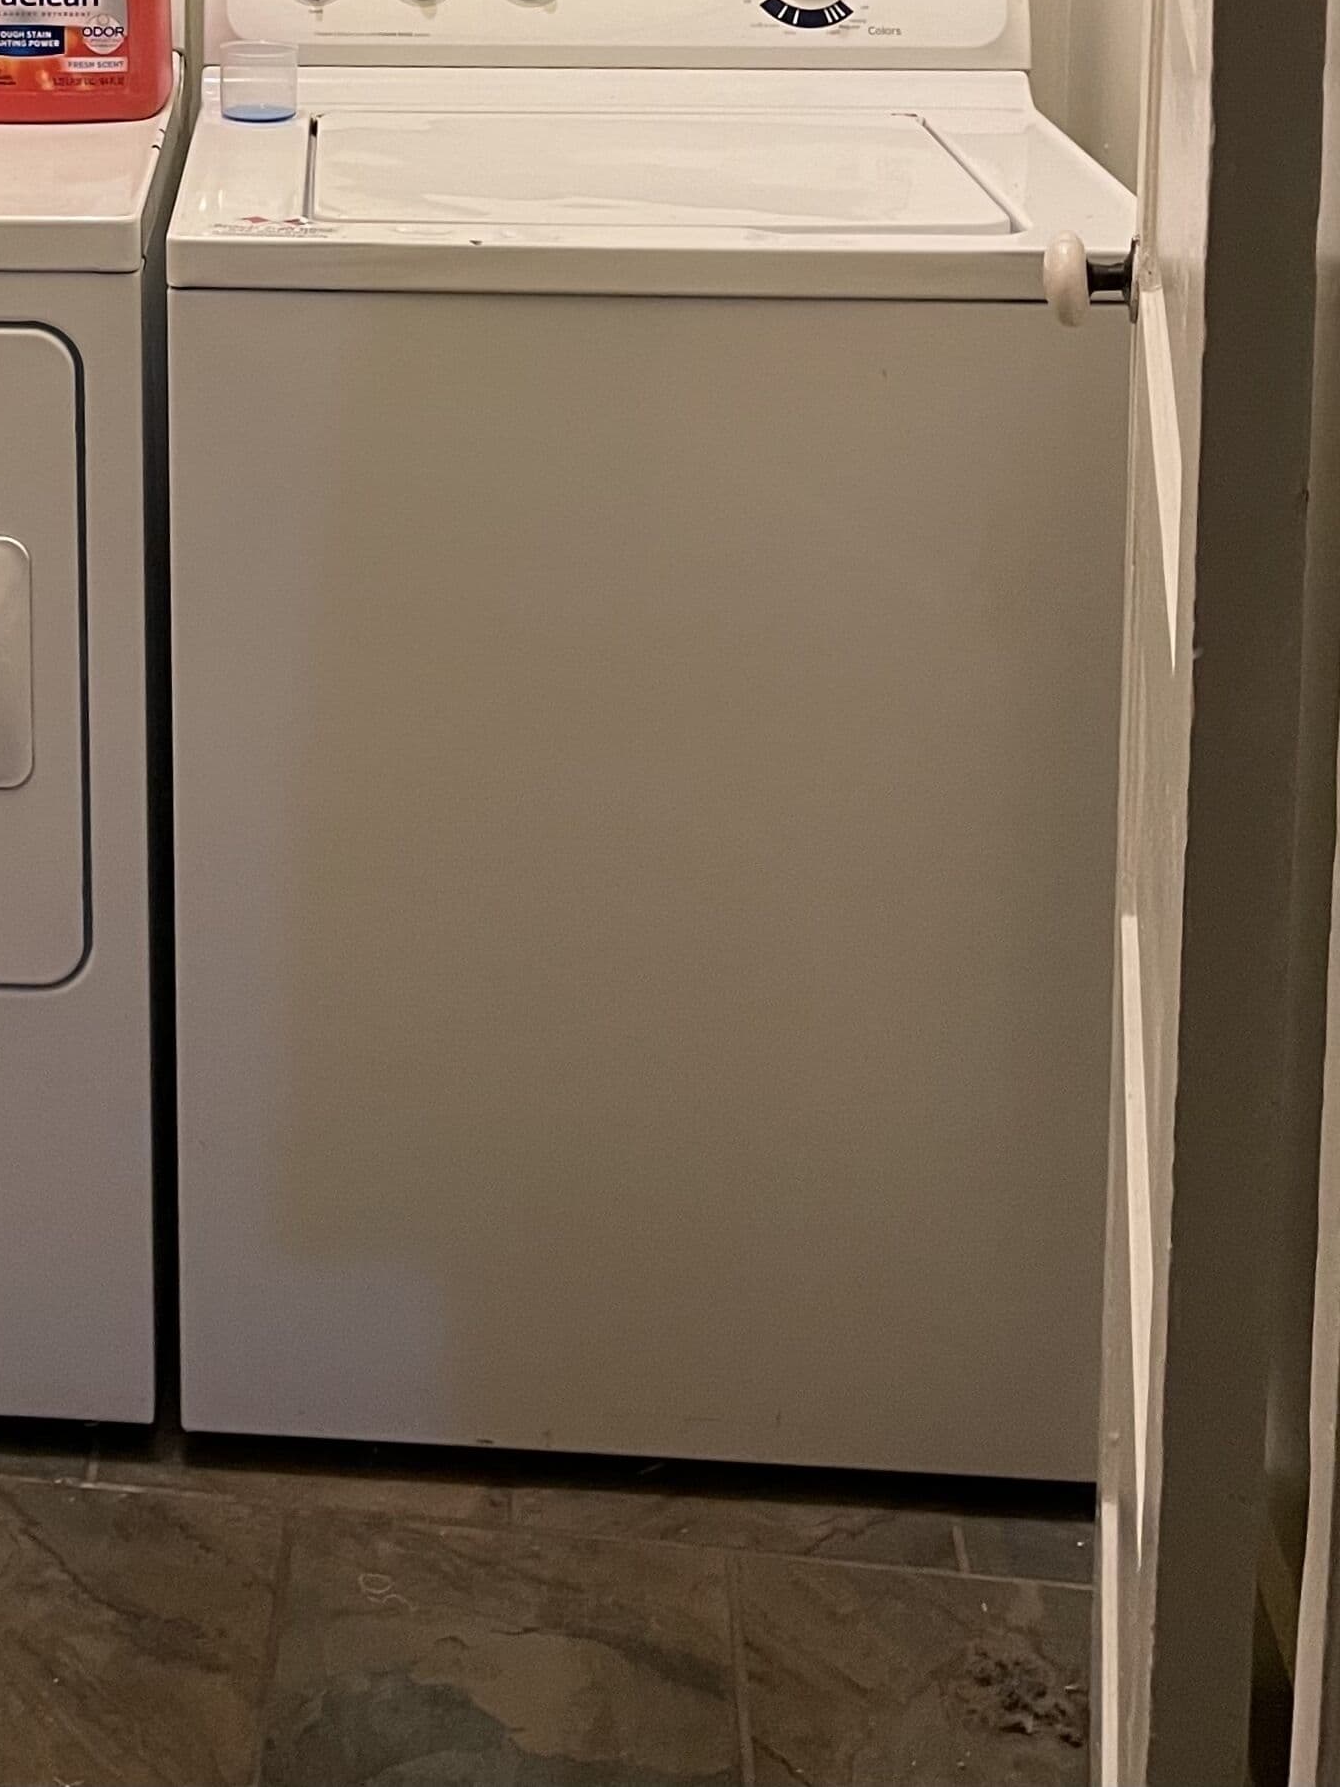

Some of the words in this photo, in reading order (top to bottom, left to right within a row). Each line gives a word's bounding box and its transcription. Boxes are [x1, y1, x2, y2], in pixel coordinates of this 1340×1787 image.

[26, 30, 52, 38] STAIN
[82, 26, 125, 38] ODOR
[868, 26, 902, 36] Colors
[28, 39, 60, 48] POWER
[67, 61, 96, 69] FRESH
[97, 60, 125, 69] SCENT
